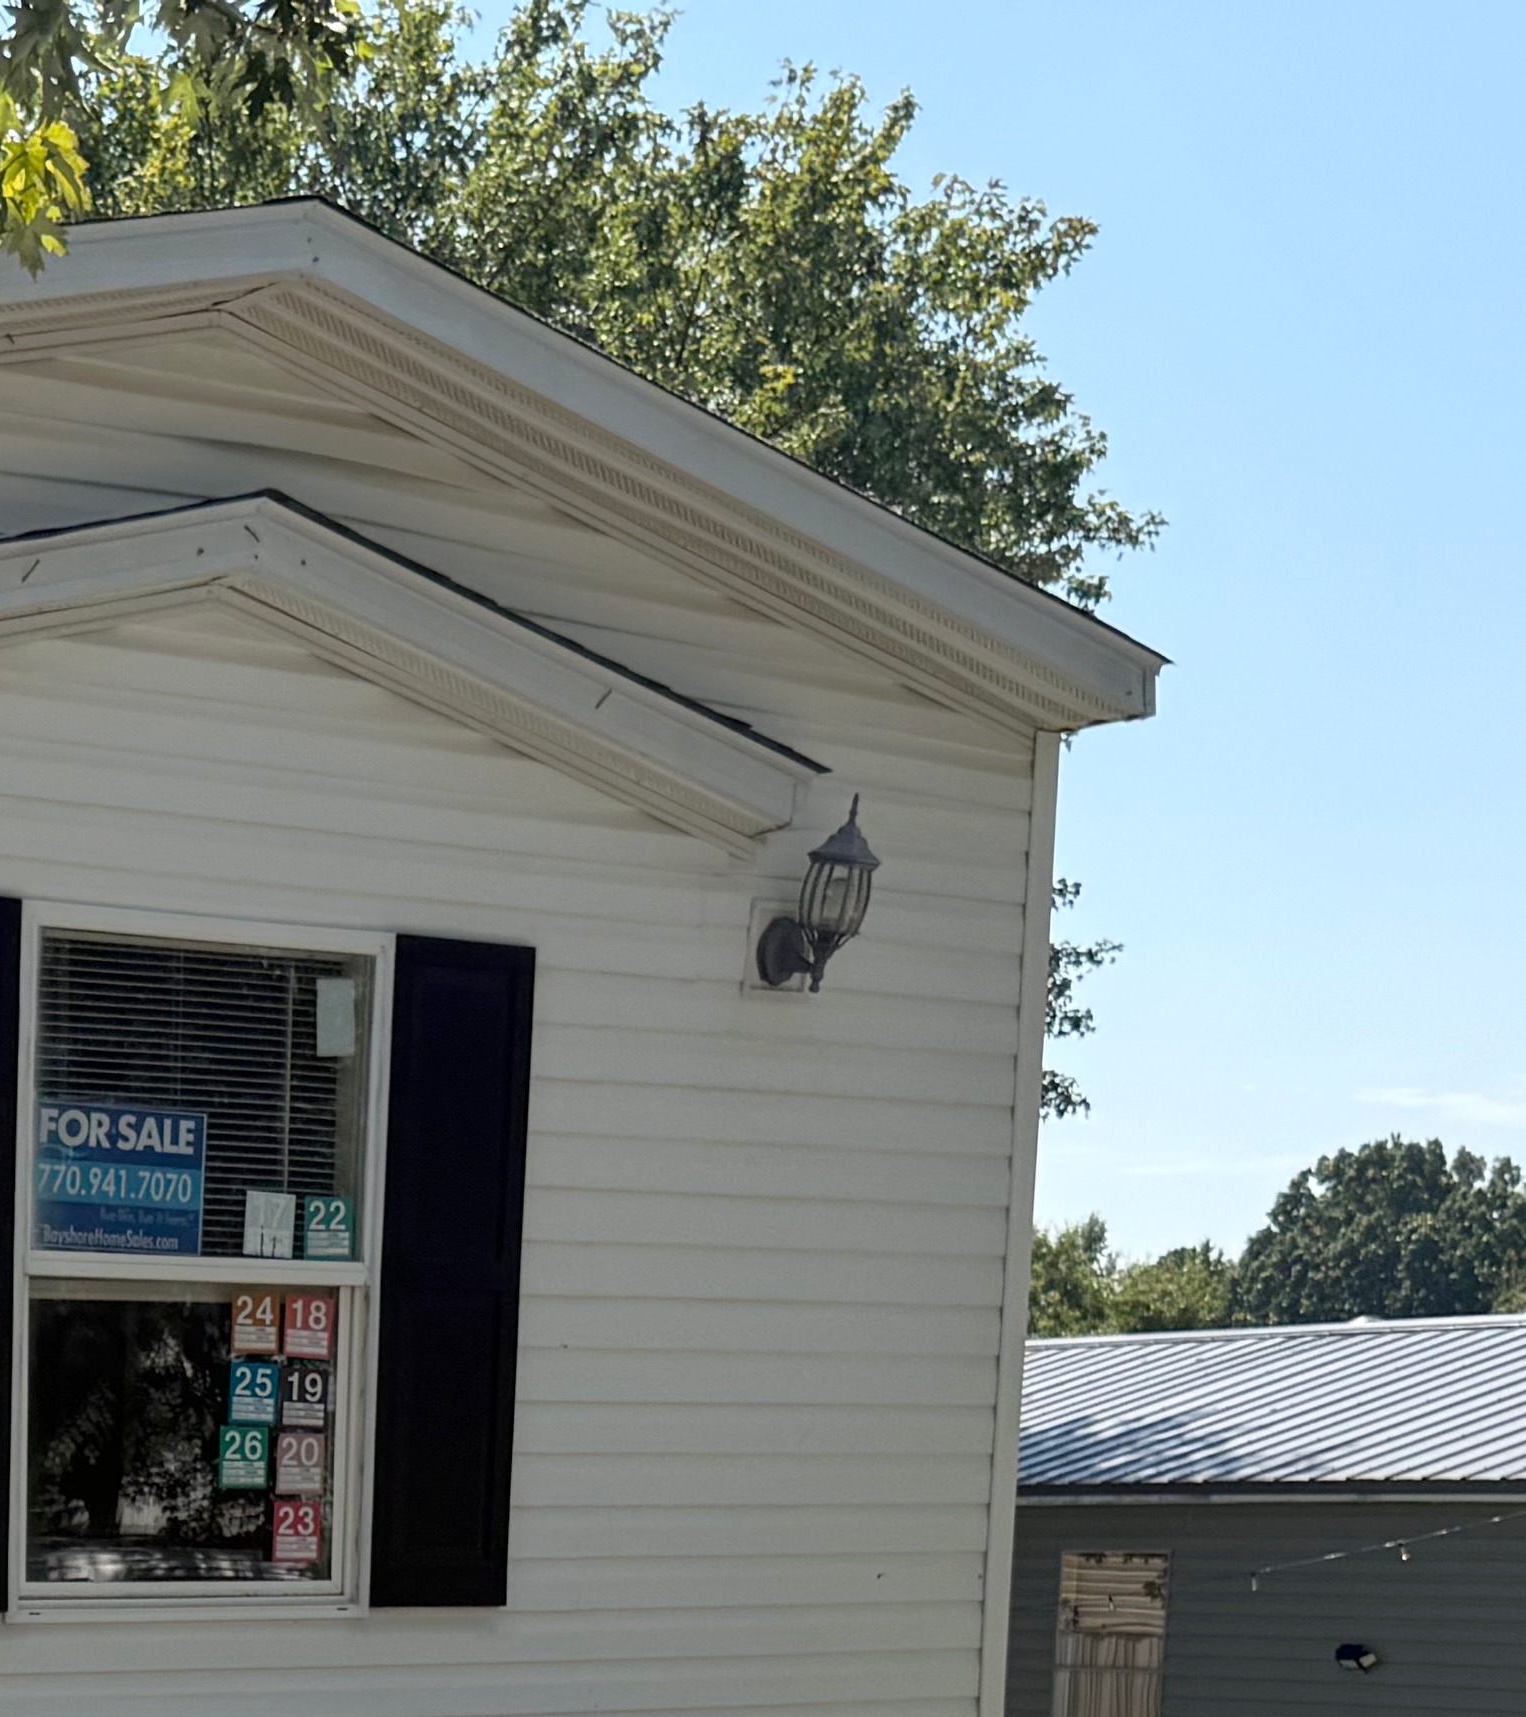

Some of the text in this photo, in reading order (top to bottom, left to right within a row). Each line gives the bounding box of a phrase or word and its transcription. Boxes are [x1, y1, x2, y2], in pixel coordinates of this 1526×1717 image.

[39, 1107, 196, 1155] FOR SALE
[37, 1163, 192, 1203] 770.941.7070
[309, 1200, 346, 1230] 22
[236, 1295, 274, 1325] 24
[291, 1299, 327, 1330] 18
[234, 1366, 273, 1397] 25
[287, 1371, 323, 1402] 19
[224, 1430, 263, 1461] 26
[281, 1437, 319, 1466] 20
[277, 1506, 315, 1536] 23
